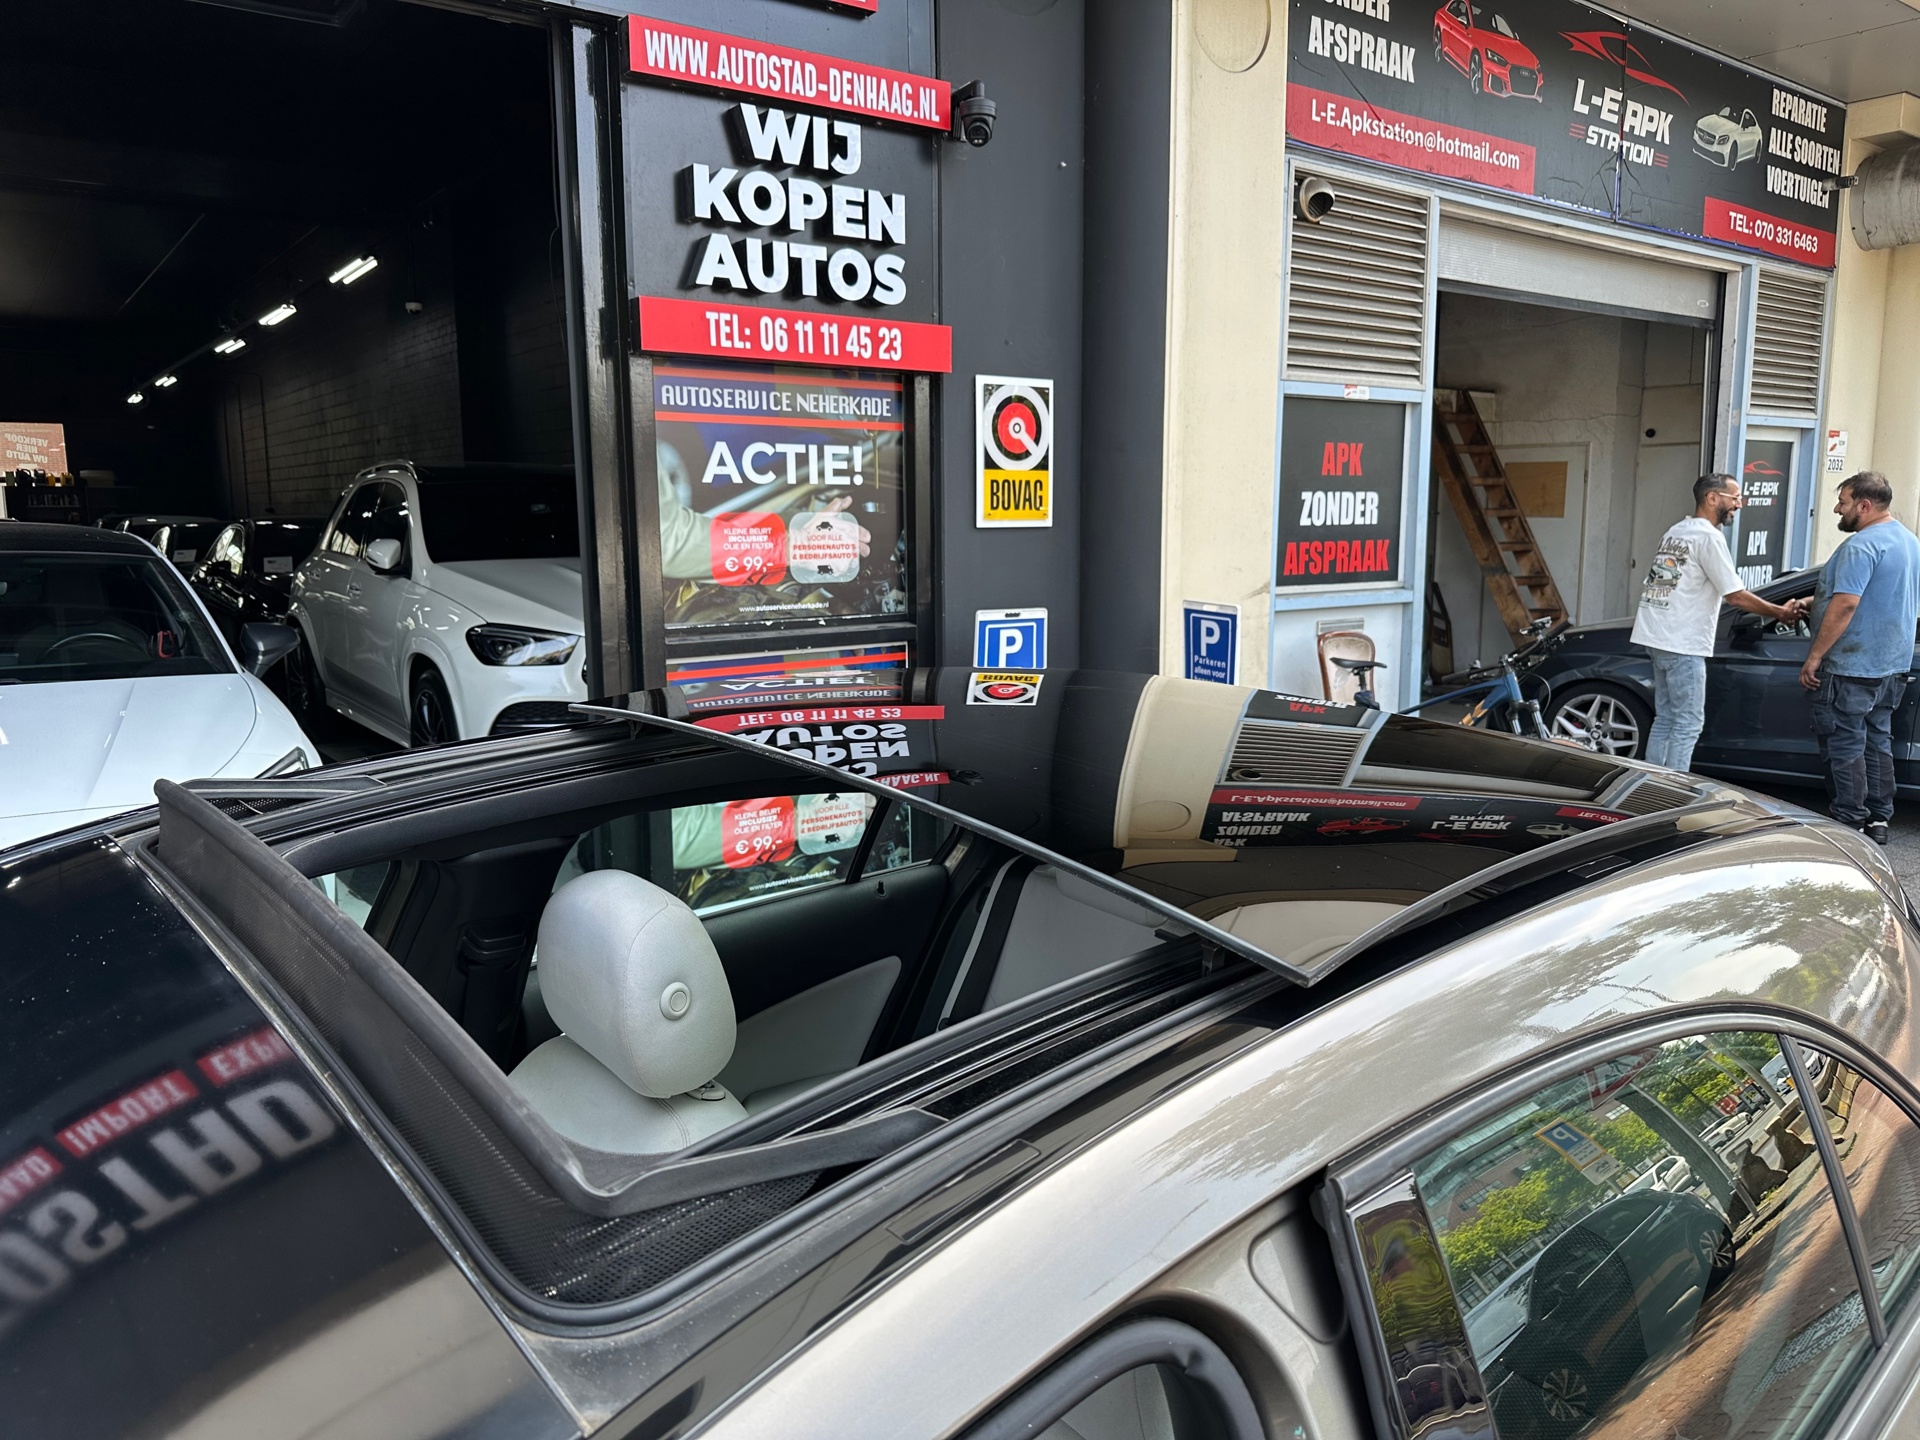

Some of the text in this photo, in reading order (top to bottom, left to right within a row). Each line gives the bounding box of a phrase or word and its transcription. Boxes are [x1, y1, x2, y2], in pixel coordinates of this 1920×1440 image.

[1308, 15, 1415, 83] AFSPRAAK
[644, 28, 940, 123] WWW.AUTOSTAD-DENHAAG.NL
[1623, 99, 1674, 145] APK
[1771, 88, 1828, 133] REPARATIE
[740, 102, 862, 175] WIJ
[1311, 98, 1520, 171] L-E.Apkstation@hotmail.com
[1586, 124, 1655, 167] STATION
[1768, 127, 1841, 175] ALLE SOORTEN
[693, 163, 906, 245] KOPEN
[1729, 211, 1818, 254] TEL: 070 331 6463
[696, 233, 907, 305] AUTOS
[705, 311, 902, 361] TEL: 06 11 11 45 23
[661, 384, 892, 417] AUTOSERVICE NEHERKADE
[701, 440, 864, 486] ACTIE!
[1321, 441, 1364, 477] APK
[1827, 458, 1843, 471] 2032
[990, 479, 1043, 511] BOVAG
[1747, 497, 1772, 506] STATION
[1760, 482, 1779, 496] APK
[1299, 490, 1379, 526] ZONDER
[728, 535, 768, 543] INCLUSIEF
[751, 542, 774, 550] FILTER
[793, 543, 856, 551] PERSONENAUTO'S
[807, 534, 827, 542] VOOR
[1747, 530, 1768, 556] APK
[799, 552, 858, 560] BEDRIJFSAUTO'S
[1283, 539, 1390, 576] AFSPRAAK
[998, 628, 1023, 668] P
[1200, 619, 1220, 657] P
[1194, 655, 1226, 669] Parkeren
[734, 807, 782, 821] KLEINE BEURT
[738, 815, 777, 826] INCLUSIEF
[761, 820, 783, 831] FILTER
[801, 810, 863, 825] PERSONENAUTO'S
[807, 818, 864, 833] BEDRIJFSAUTO'S
[815, 805, 834, 814] VOOR
